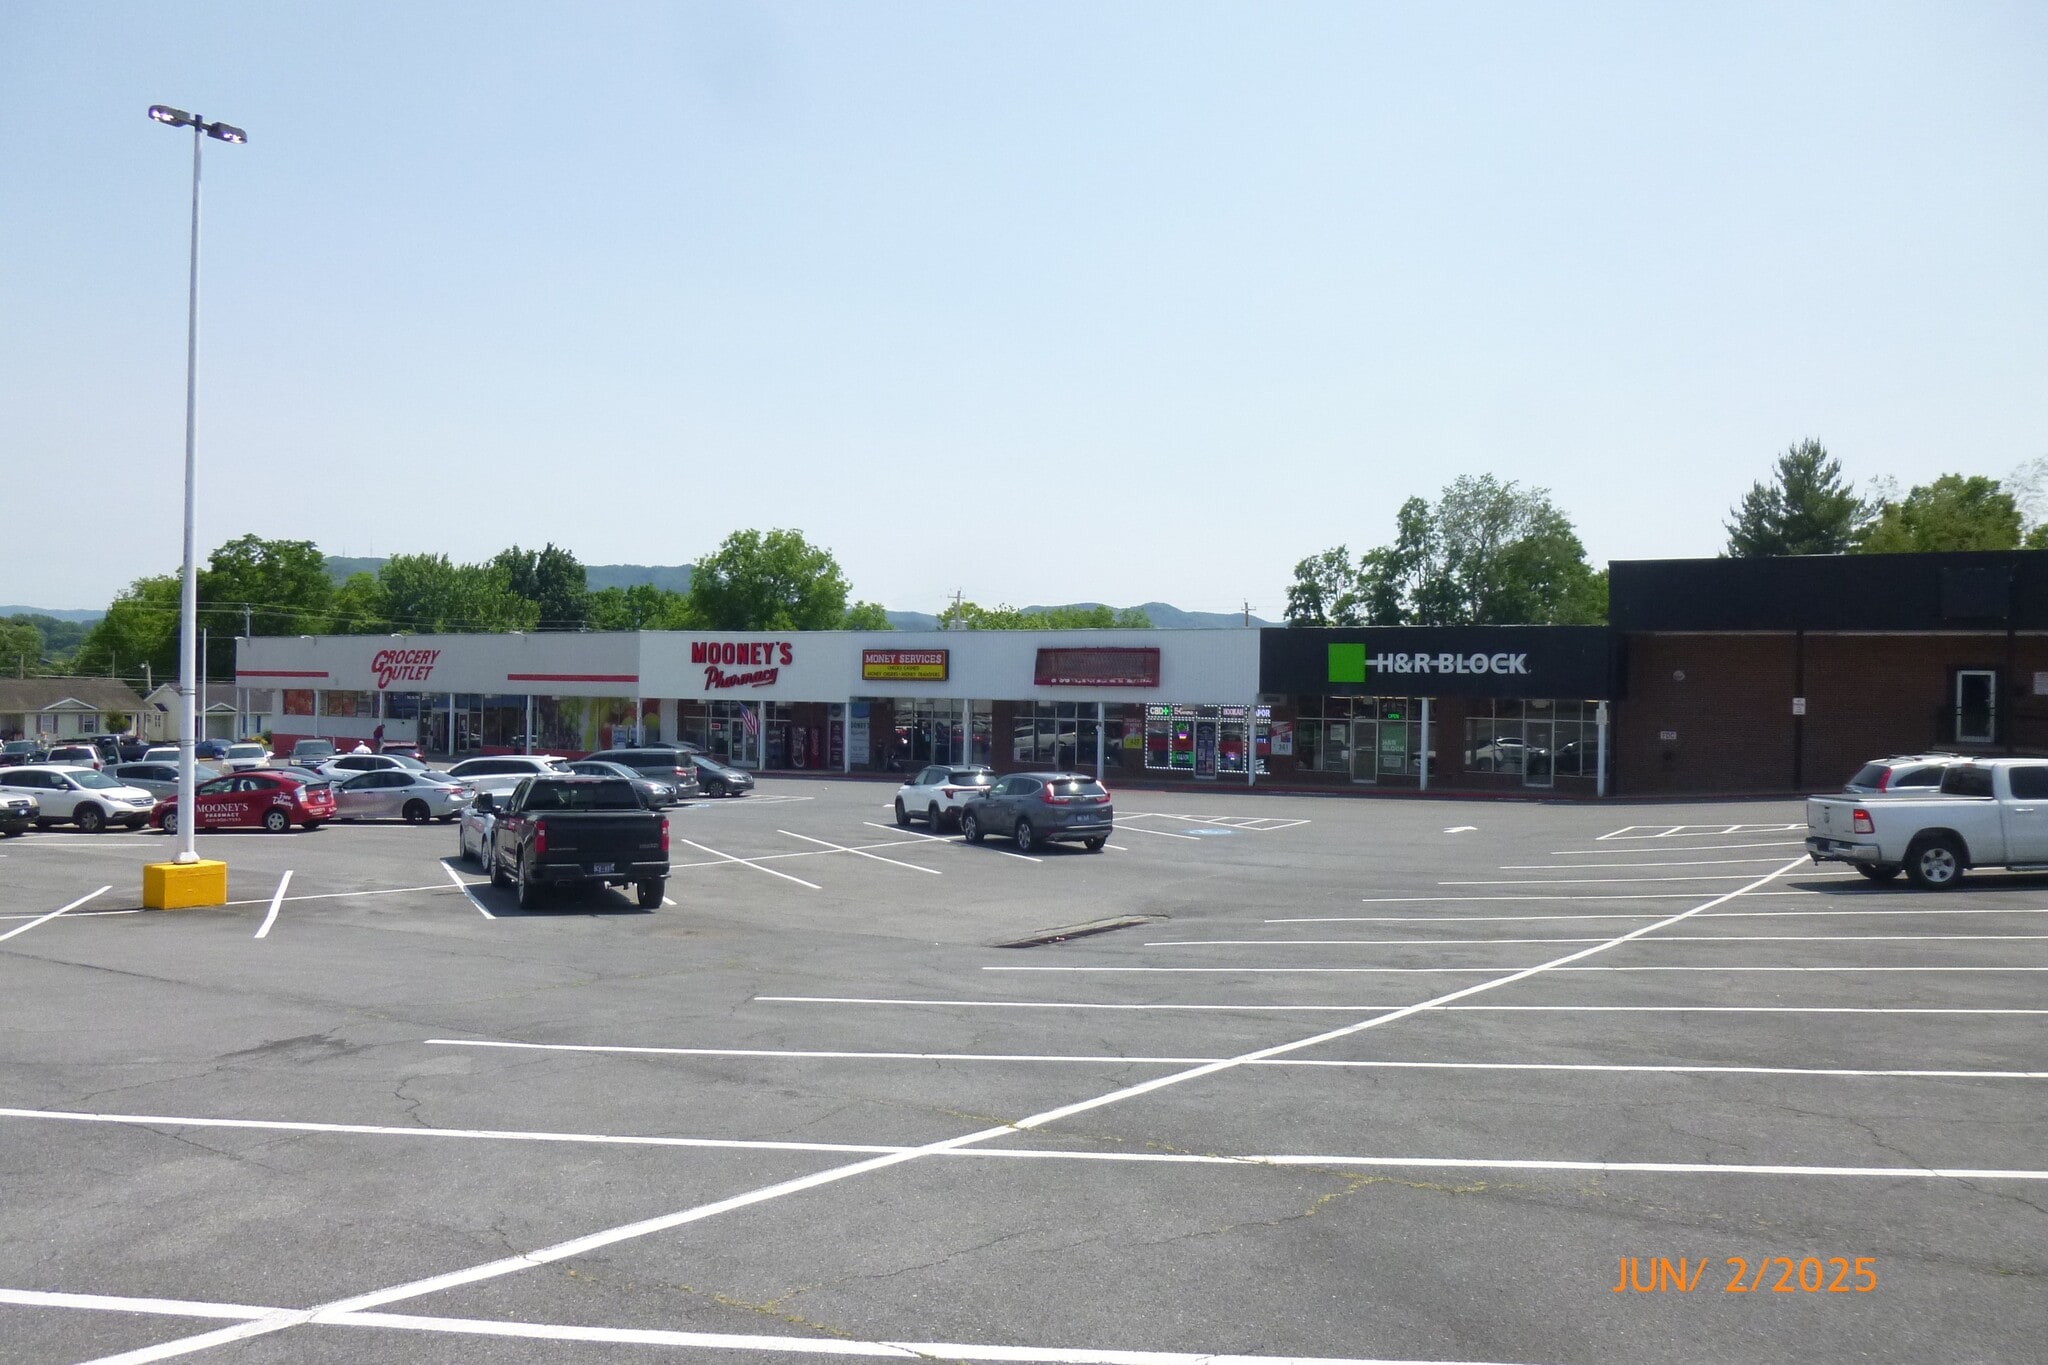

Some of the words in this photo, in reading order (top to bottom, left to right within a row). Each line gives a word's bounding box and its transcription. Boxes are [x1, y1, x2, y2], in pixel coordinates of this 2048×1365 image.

[371, 649, 441, 673] GROCERY
[691, 642, 793, 665] MOONEY'S
[866, 654, 896, 663] MONEY
[899, 654, 942, 663] SERVICES
[1377, 653, 1430, 673] H&R
[1438, 653, 1529, 673] BLOCK
[378, 665, 433, 689] OUTLET
[703, 666, 779, 691] Pharmacy
[196, 803, 249, 813] MOONEY'S
